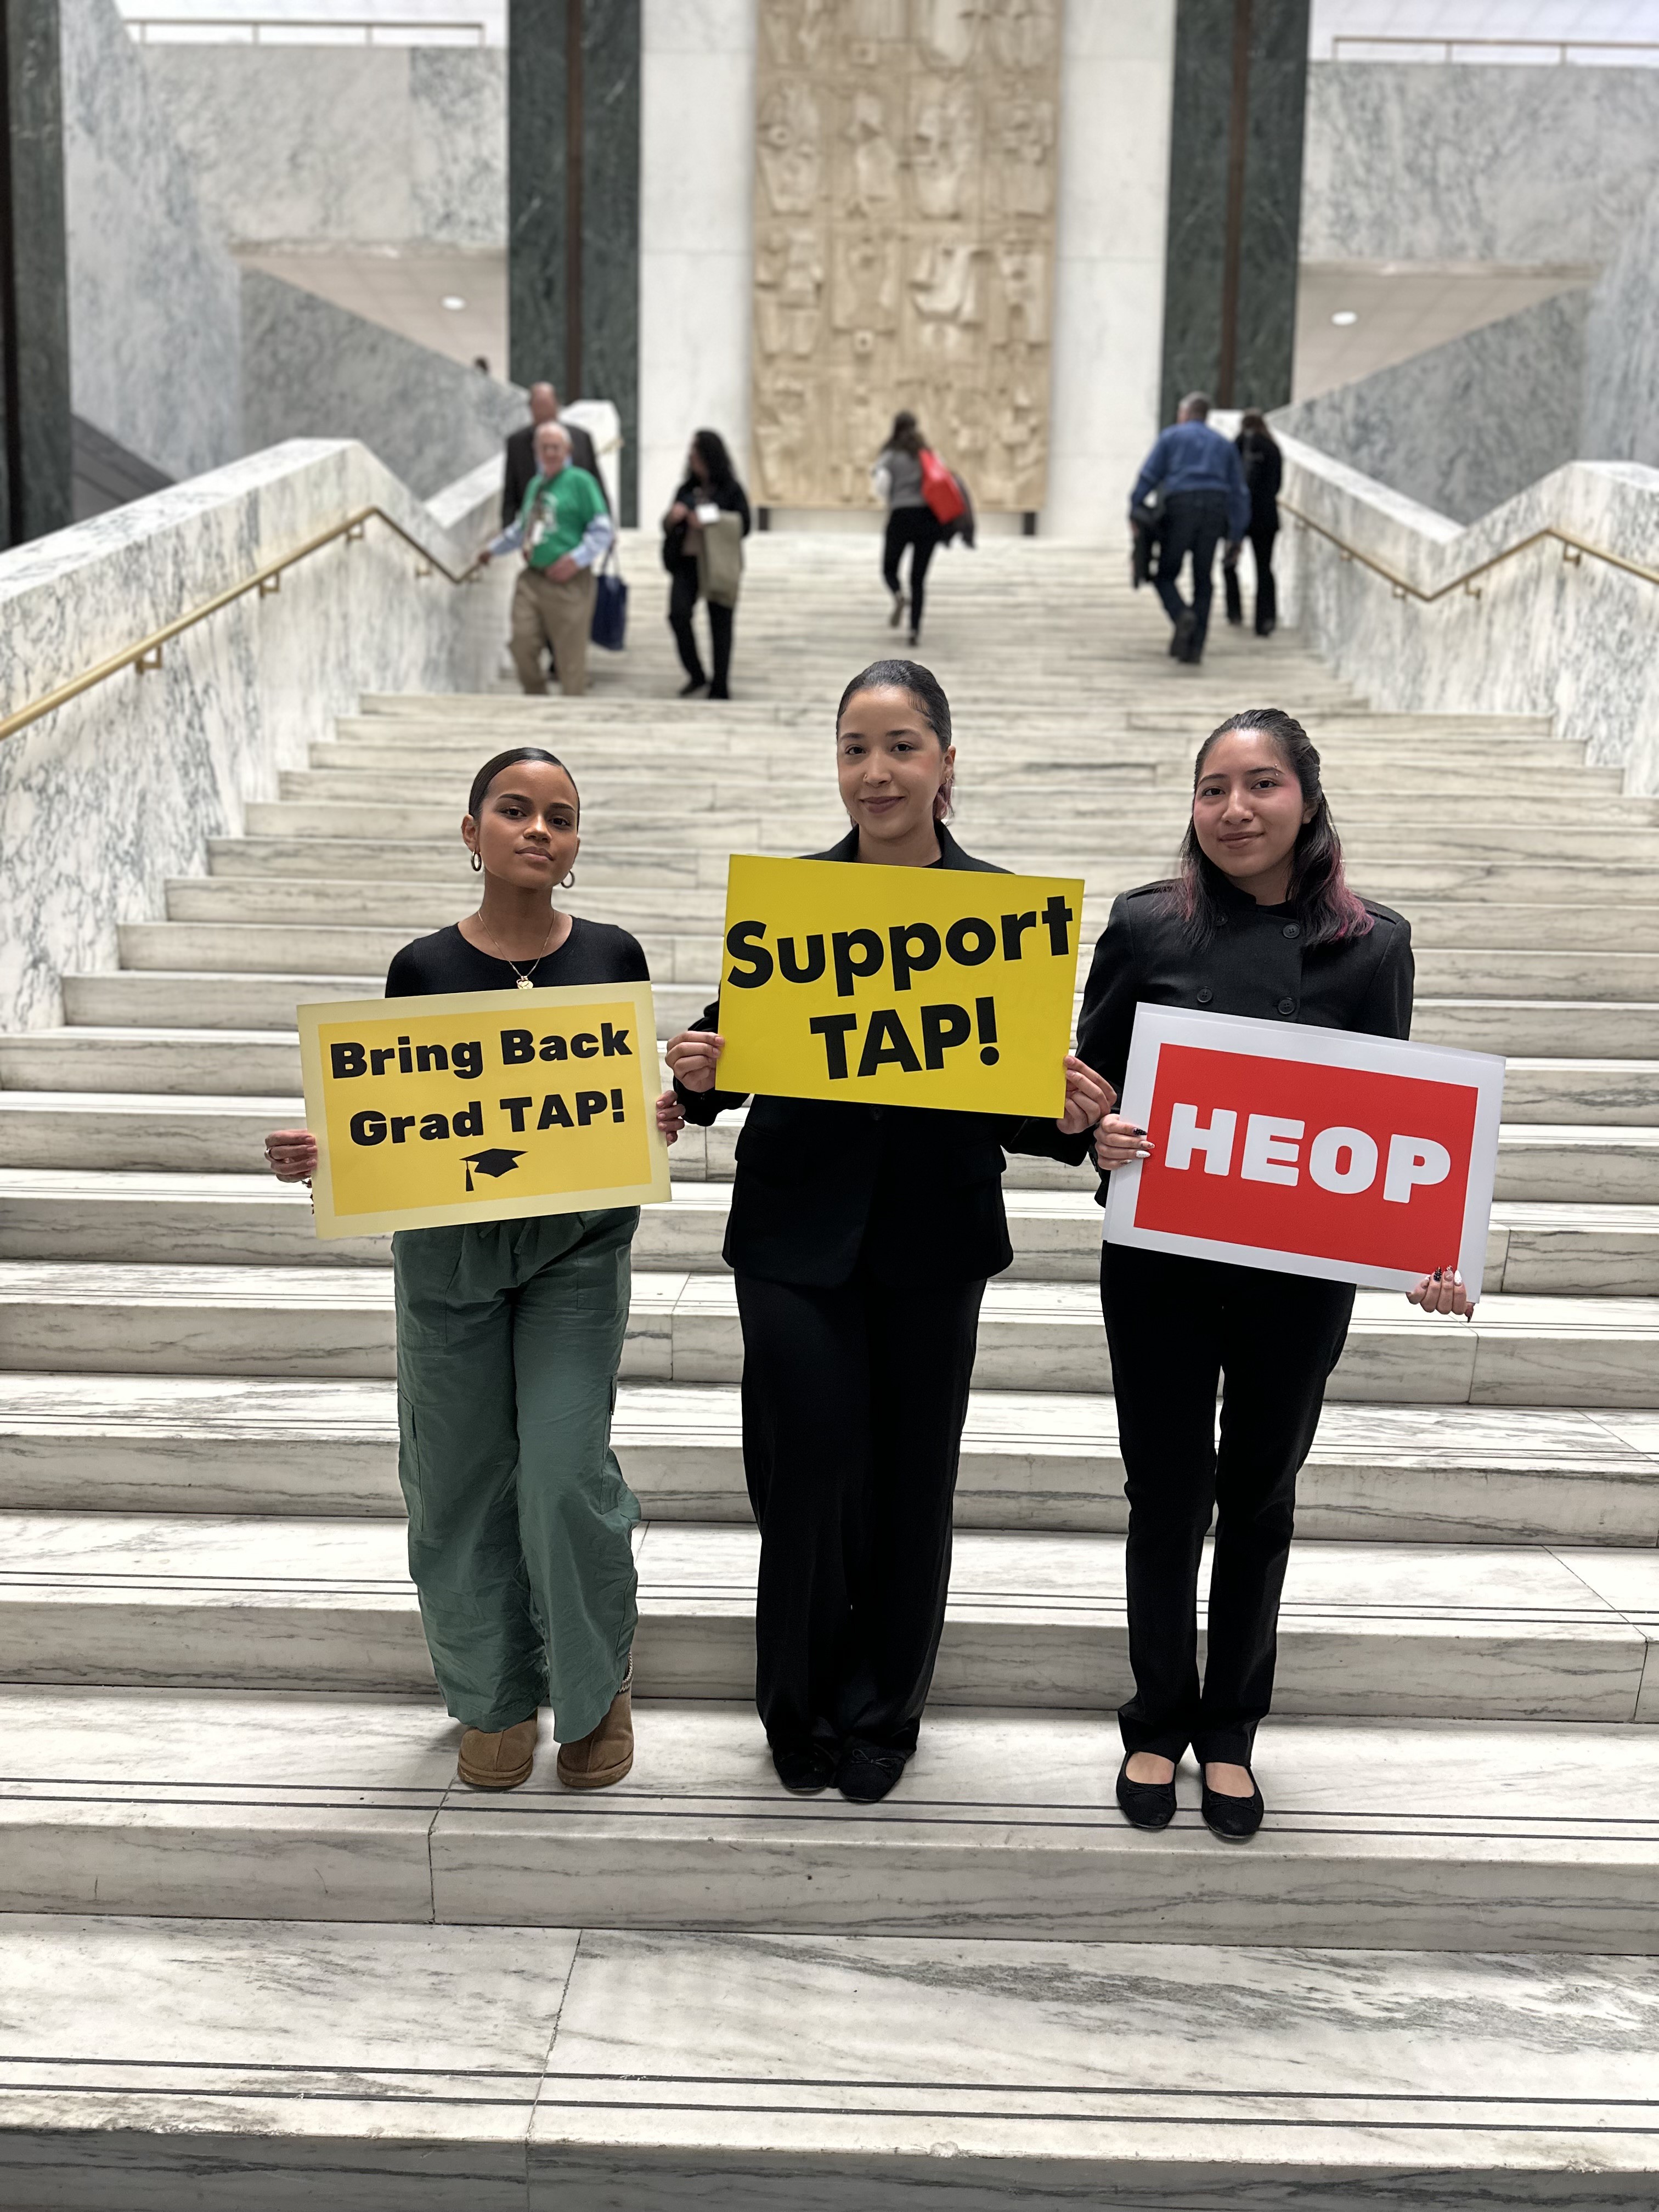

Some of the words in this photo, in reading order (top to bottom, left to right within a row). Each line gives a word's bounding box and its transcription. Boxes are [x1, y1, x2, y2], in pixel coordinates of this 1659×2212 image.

[726, 895, 1073, 997] Support
[330, 1036, 483, 1080] Bring
[500, 1023, 633, 1065] Back
[809, 996, 1000, 1080] TAP!
[349, 1101, 484, 1147] Grad
[500, 1088, 625, 1132] TAP!
[1164, 1102, 1451, 1204] HEOP
